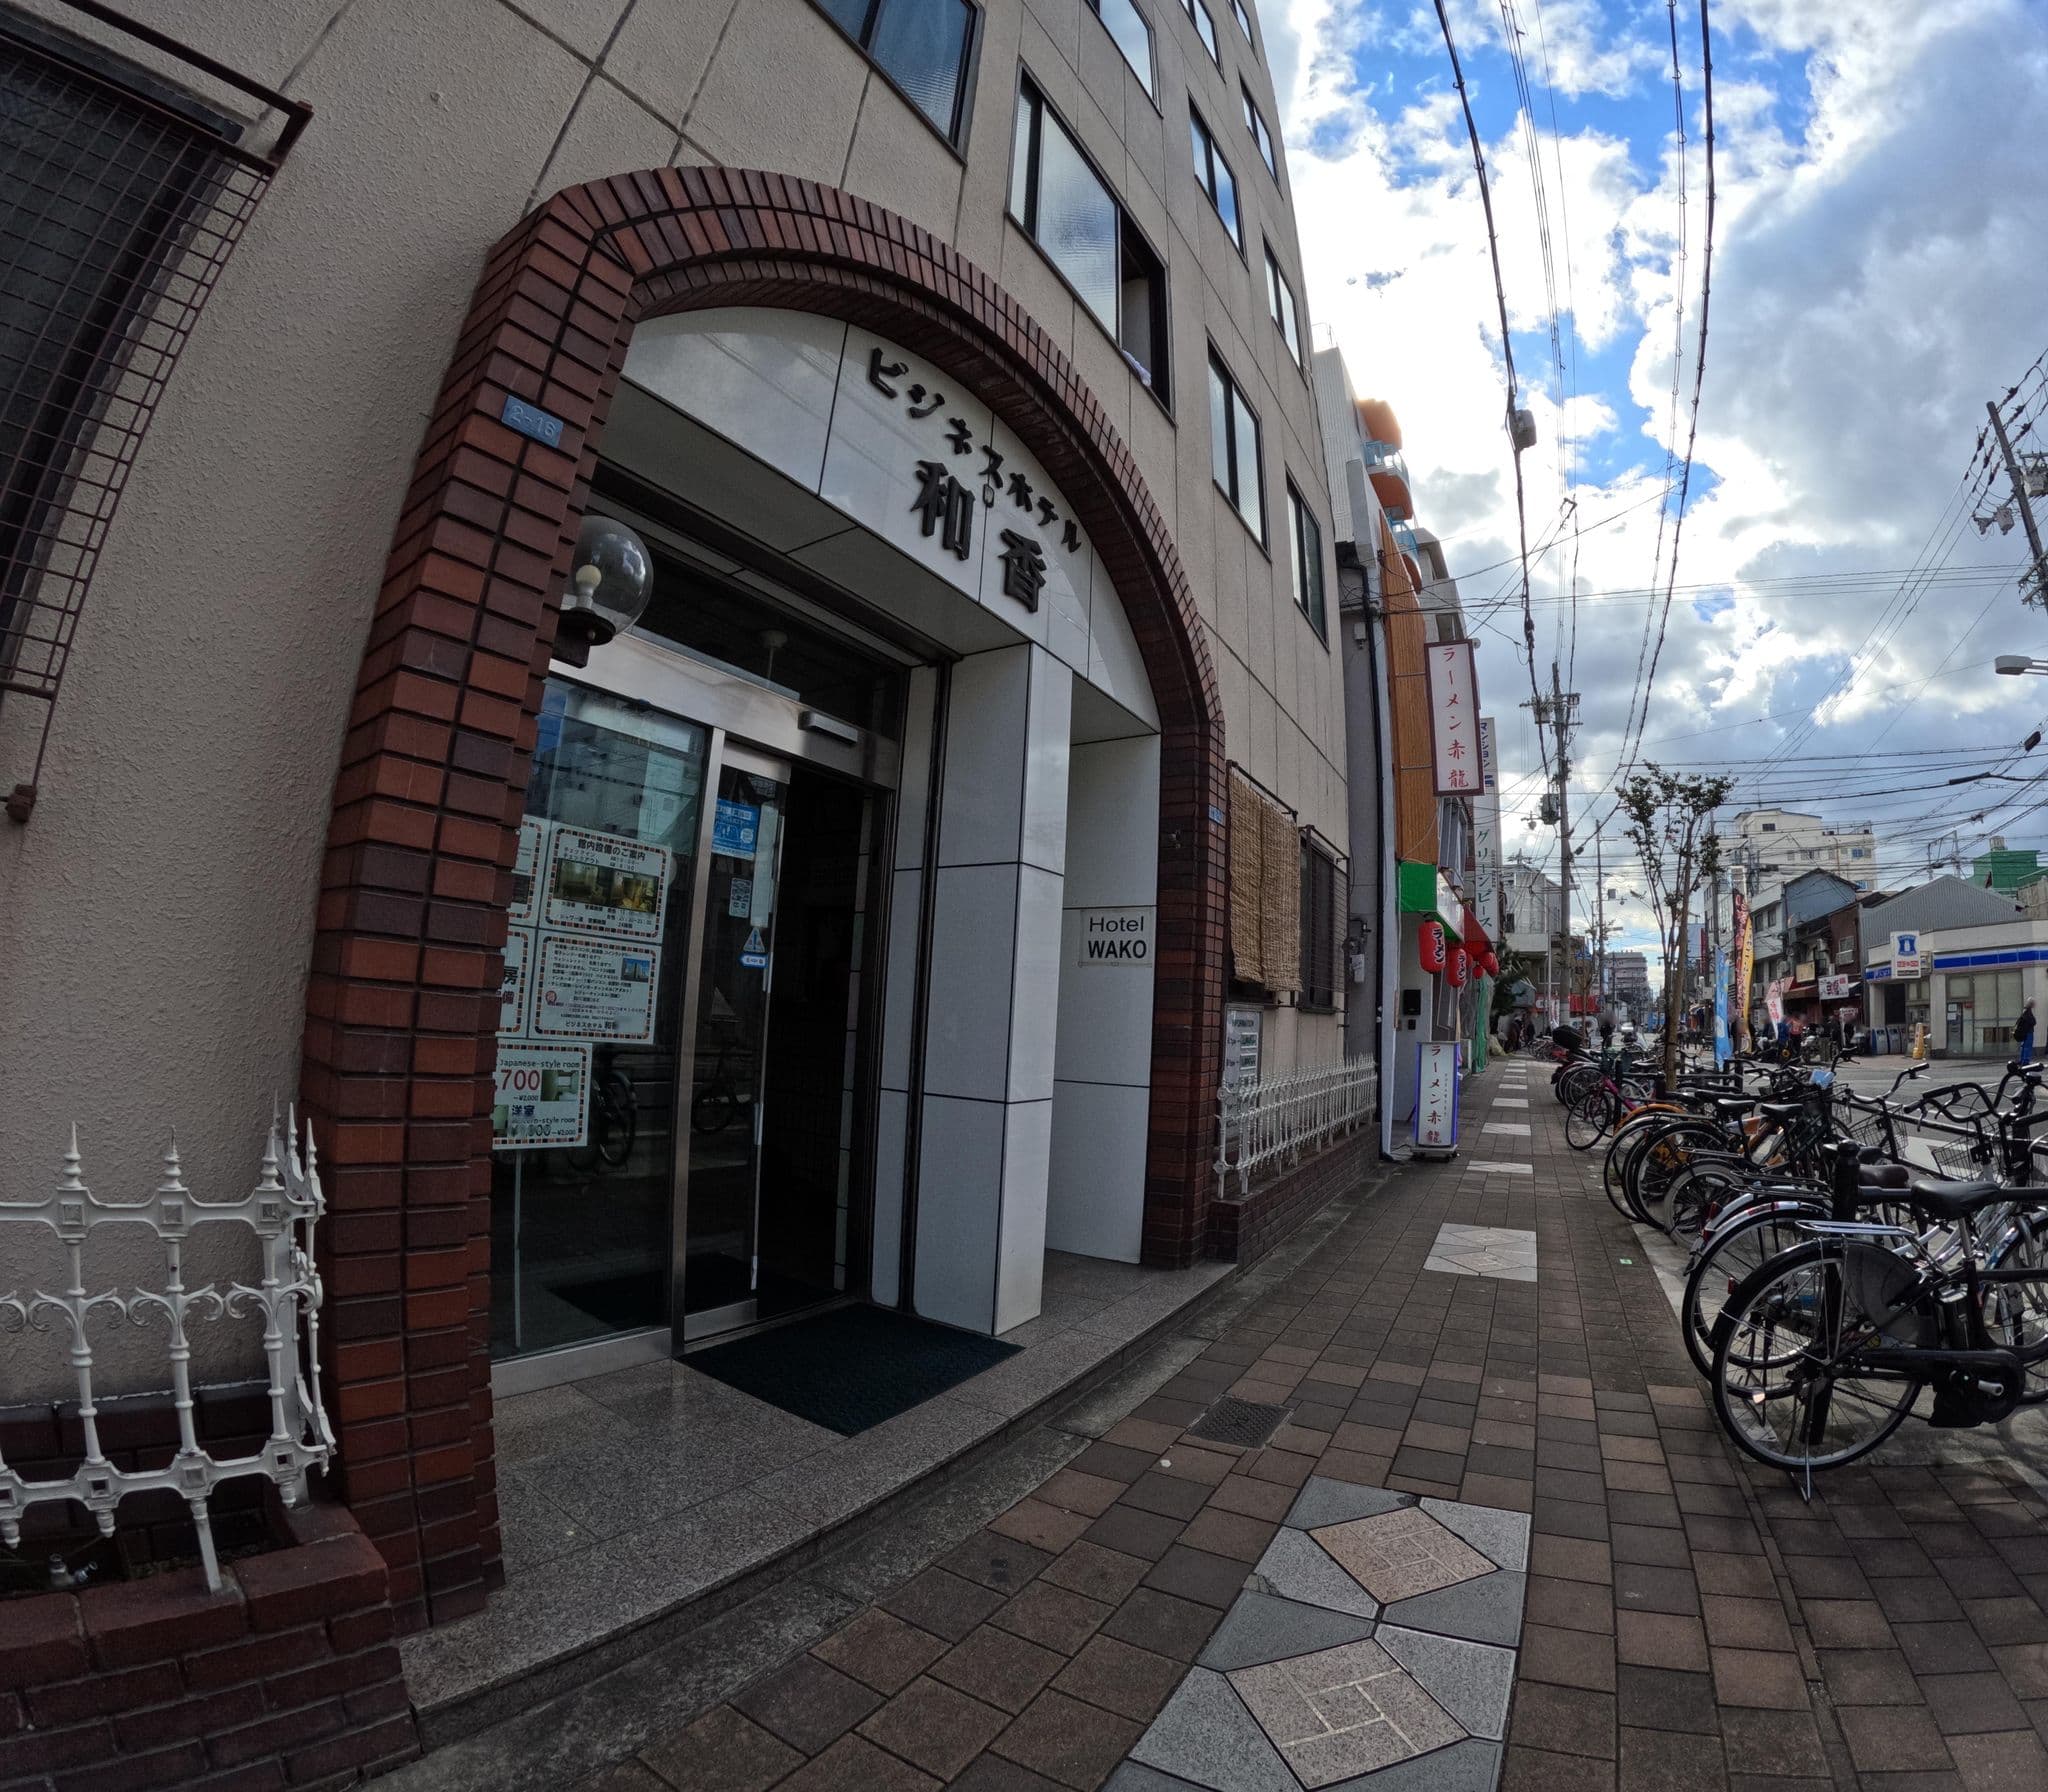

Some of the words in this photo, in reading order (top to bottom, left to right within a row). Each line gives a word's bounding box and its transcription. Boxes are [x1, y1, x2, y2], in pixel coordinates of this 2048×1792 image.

[866, 347, 1082, 553] ビジネスホテル
[910, 459, 1047, 614] 和香
[1443, 647, 1470, 788] ラーメン赤龍
[1088, 940, 1147, 959] WAKO
[1089, 916, 1144, 932] Hotel
[1432, 928, 1445, 964] ラーメン
